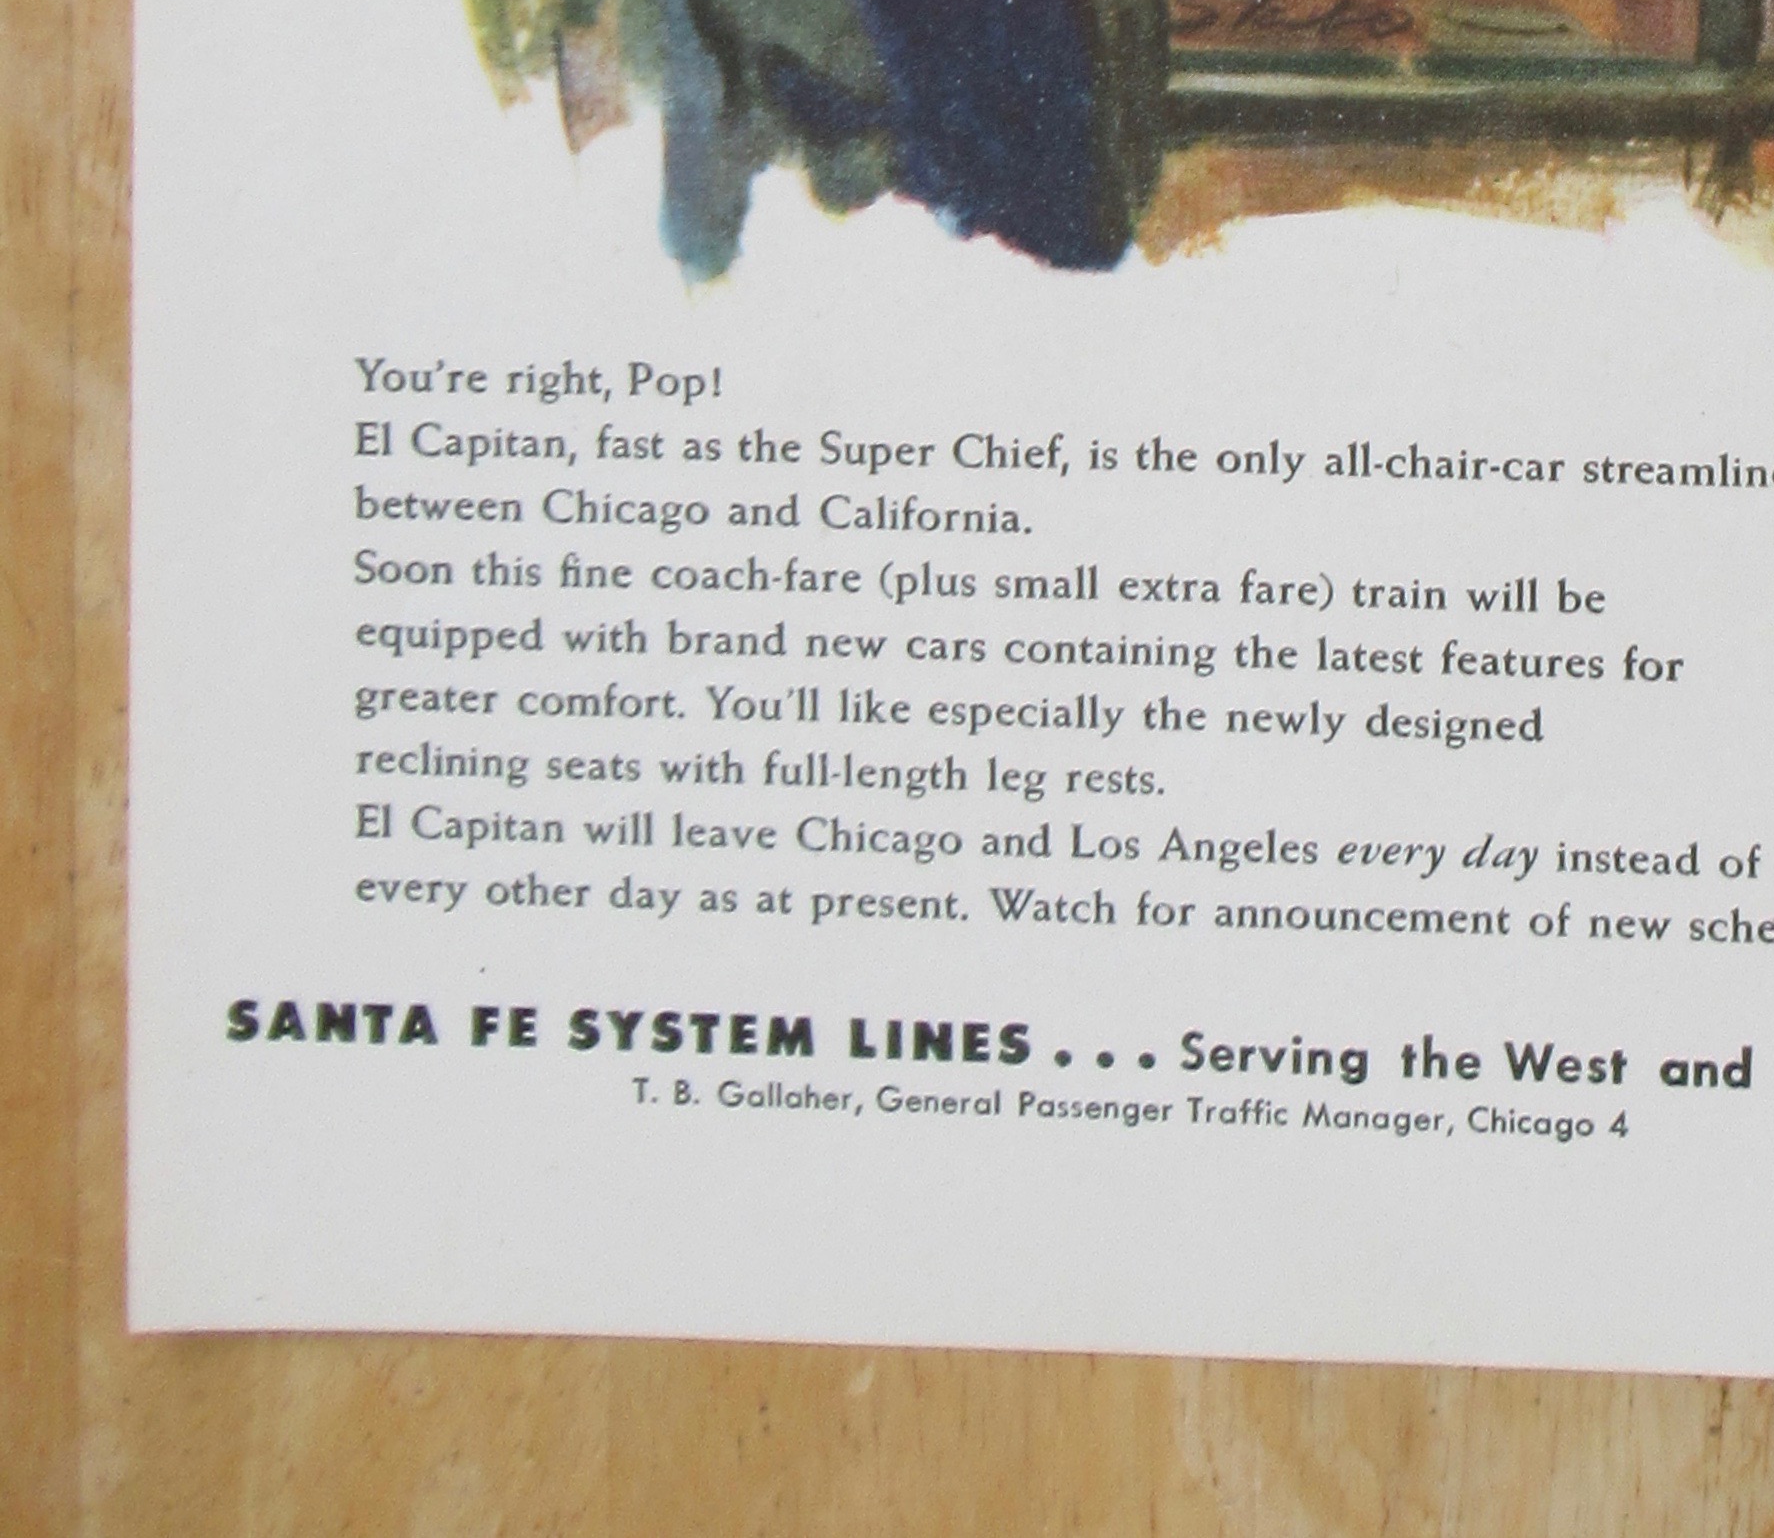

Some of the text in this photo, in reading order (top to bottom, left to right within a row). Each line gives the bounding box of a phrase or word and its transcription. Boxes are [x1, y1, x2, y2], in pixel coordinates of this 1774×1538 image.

[353, 356, 722, 408] You're right, Pop!
[354, 420, 393, 458] El
[409, 420, 578, 468] Capitan,
[595, 422, 665, 461] fast
[681, 437, 723, 463] as
[736, 426, 803, 465] the
[819, 428, 937, 477] Super
[951, 431, 1071, 478] Chief,
[1088, 438, 1119, 472] is
[1134, 434, 1199, 474] the
[1215, 438, 1307, 486] only
[1323, 439, 1567, 484] all-chair-car
[352, 483, 1033, 536] between Chicago and California.
[353, 547, 1607, 616] Soon this fine coach-fare (plus small extra fare) train will be
[354, 616, 1686, 683] equipped with brand new cars containing the latest features for
[354, 681, 1546, 751] greater comfort. You'll like especially the newly designed
[355, 740, 1166, 804] reclining seats with full-length leg rests.
[354, 802, 1763, 883] El Capitan will leave Chicago and Los Angeles every day instead of
[354, 877, 469, 914] every
[484, 870, 592, 909] other
[608, 874, 682, 920] day
[698, 888, 739, 914] as
[755, 887, 794, 916] at
[810, 891, 970, 927] present.
[988, 886, 1117, 926] Watch
[1136, 889, 1197, 928] for
[1213, 904, 1512, 937] announcement
[1527, 900, 1572, 939] of
[1588, 914, 1673, 942] new
[225, 997, 440, 1047] SANTA
[469, 1004, 539, 1049] FE
[566, 1006, 816, 1059] SYSTEM
[848, 1016, 1032, 1067] LINES
[1179, 1029, 1370, 1087] Serving
[1399, 1032, 1483, 1082] the
[1502, 1040, 1629, 1087] West
[1658, 1044, 1754, 1091] and
[630, 1075, 1631, 1145] T. B. Gallaher, General Passenger Traffic Manager, Chicago 4
